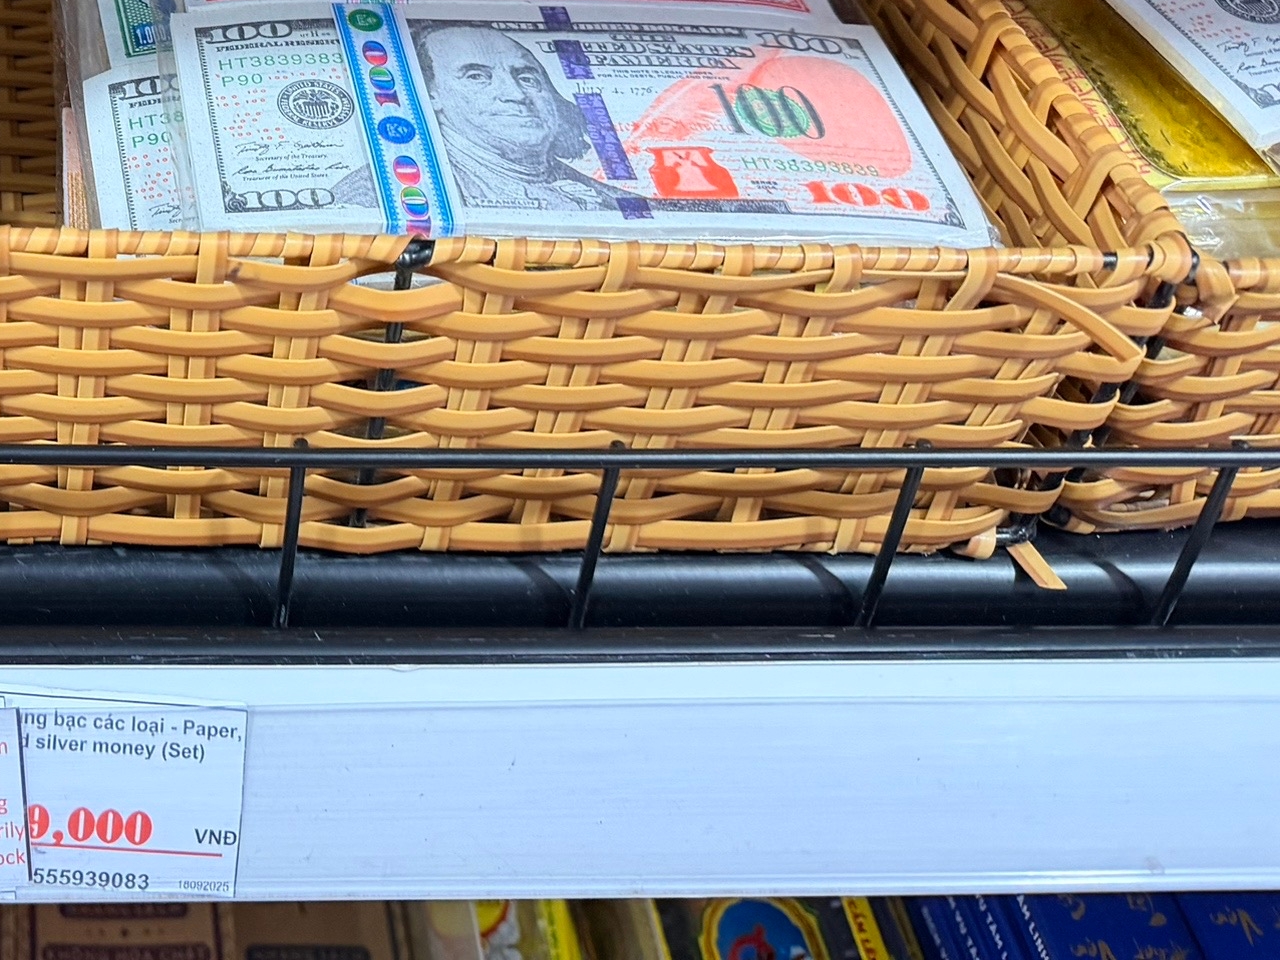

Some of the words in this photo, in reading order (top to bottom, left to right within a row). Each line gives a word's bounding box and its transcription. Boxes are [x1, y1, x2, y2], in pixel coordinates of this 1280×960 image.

[206, 22, 293, 44] 100
[755, 31, 842, 54] 100
[218, 52, 344, 71] HT3839383
[222, 73, 263, 88] P90
[361, 40, 401, 108] 100
[709, 83, 826, 139] 100
[131, 132, 171, 148] P90
[741, 156, 879, 177] HT38393839
[242, 188, 336, 209] 100
[802, 181, 931, 212] 100
[54, 708, 87, 731] bạc
[93, 713, 125, 731] các
[131, 716, 165, 737] loại
[183, 719, 243, 741] Paper,
[35, 734, 88, 752] silver
[92, 740, 156, 760] money
[162, 742, 205, 763] (Set)
[194, 828, 237, 846] VNĐ
[33, 868, 150, 890] 555939083
